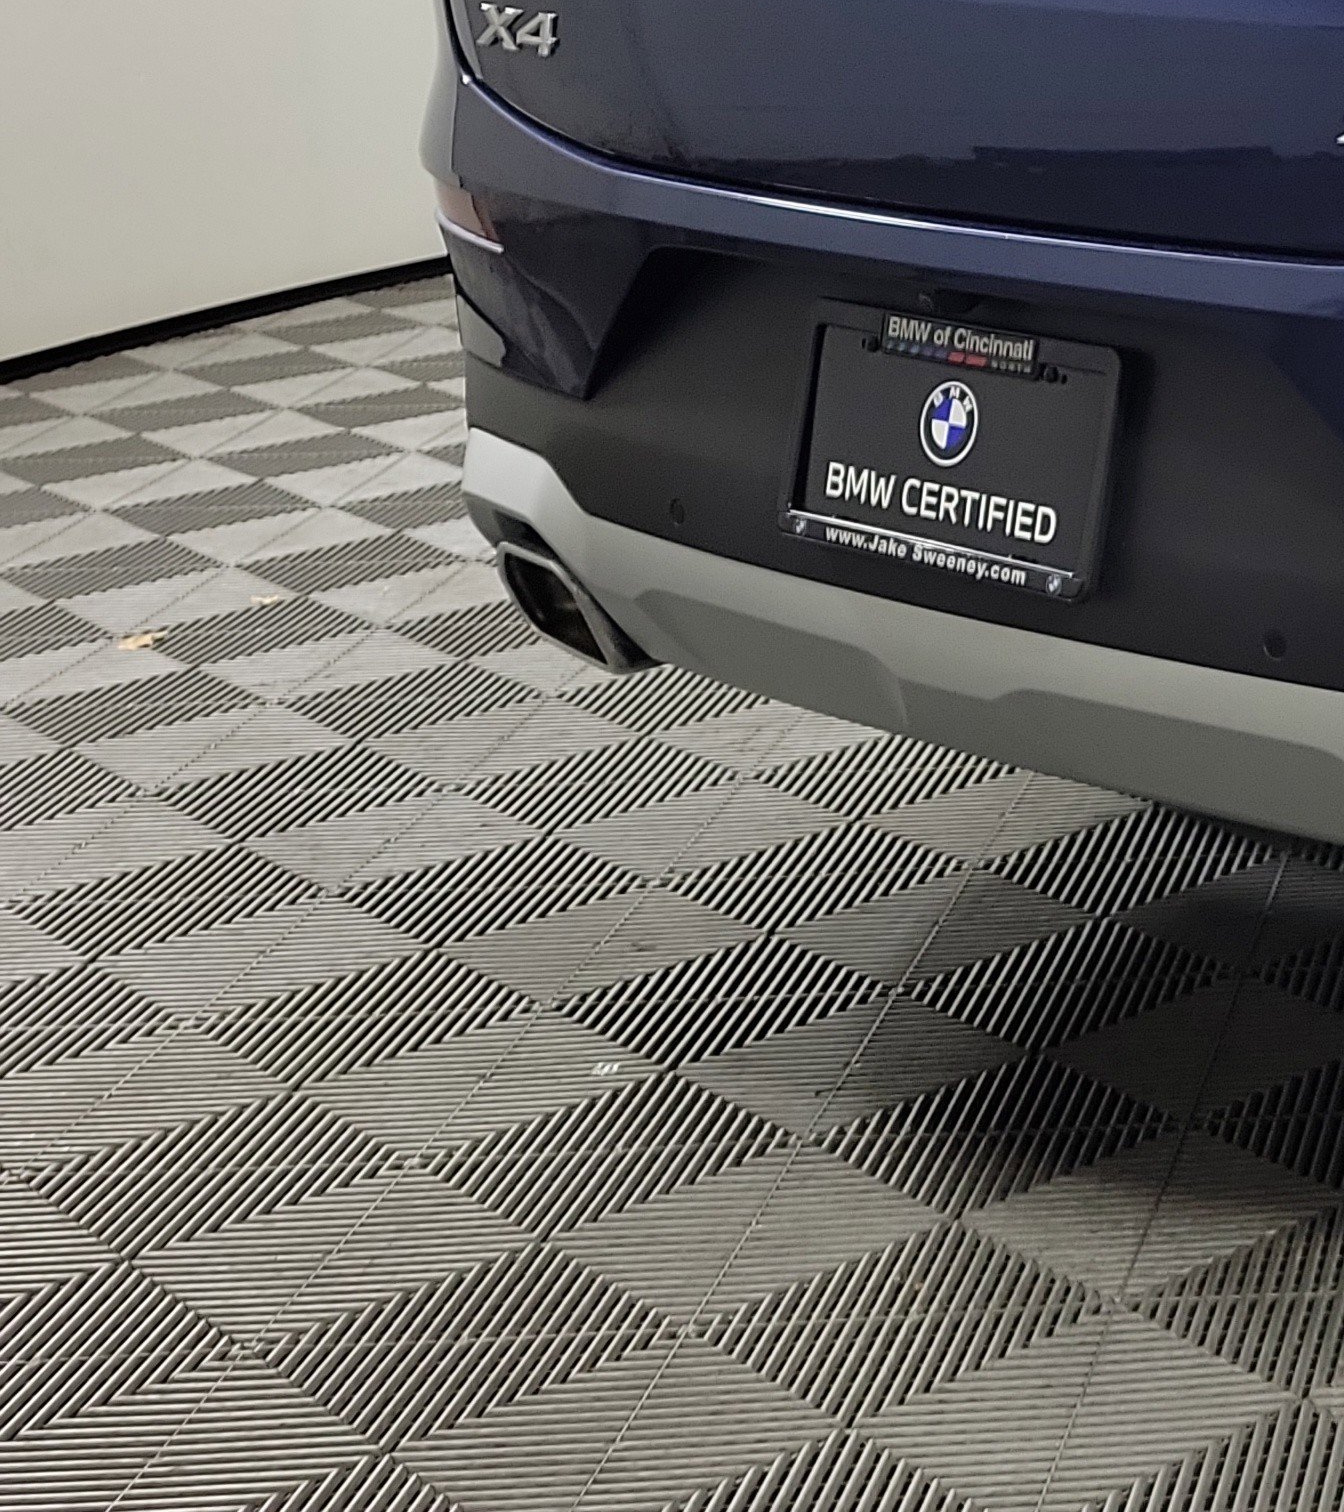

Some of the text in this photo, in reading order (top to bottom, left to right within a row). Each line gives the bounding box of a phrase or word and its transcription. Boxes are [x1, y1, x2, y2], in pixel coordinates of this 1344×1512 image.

[476, 2, 558, 58] X4
[888, 315, 1036, 361] BMW of Cincinnati
[932, 386, 974, 413] BMW
[825, 461, 1057, 545] BMW CERTIFIED
[825, 525, 1028, 586] www.Jake Sweeney.com
